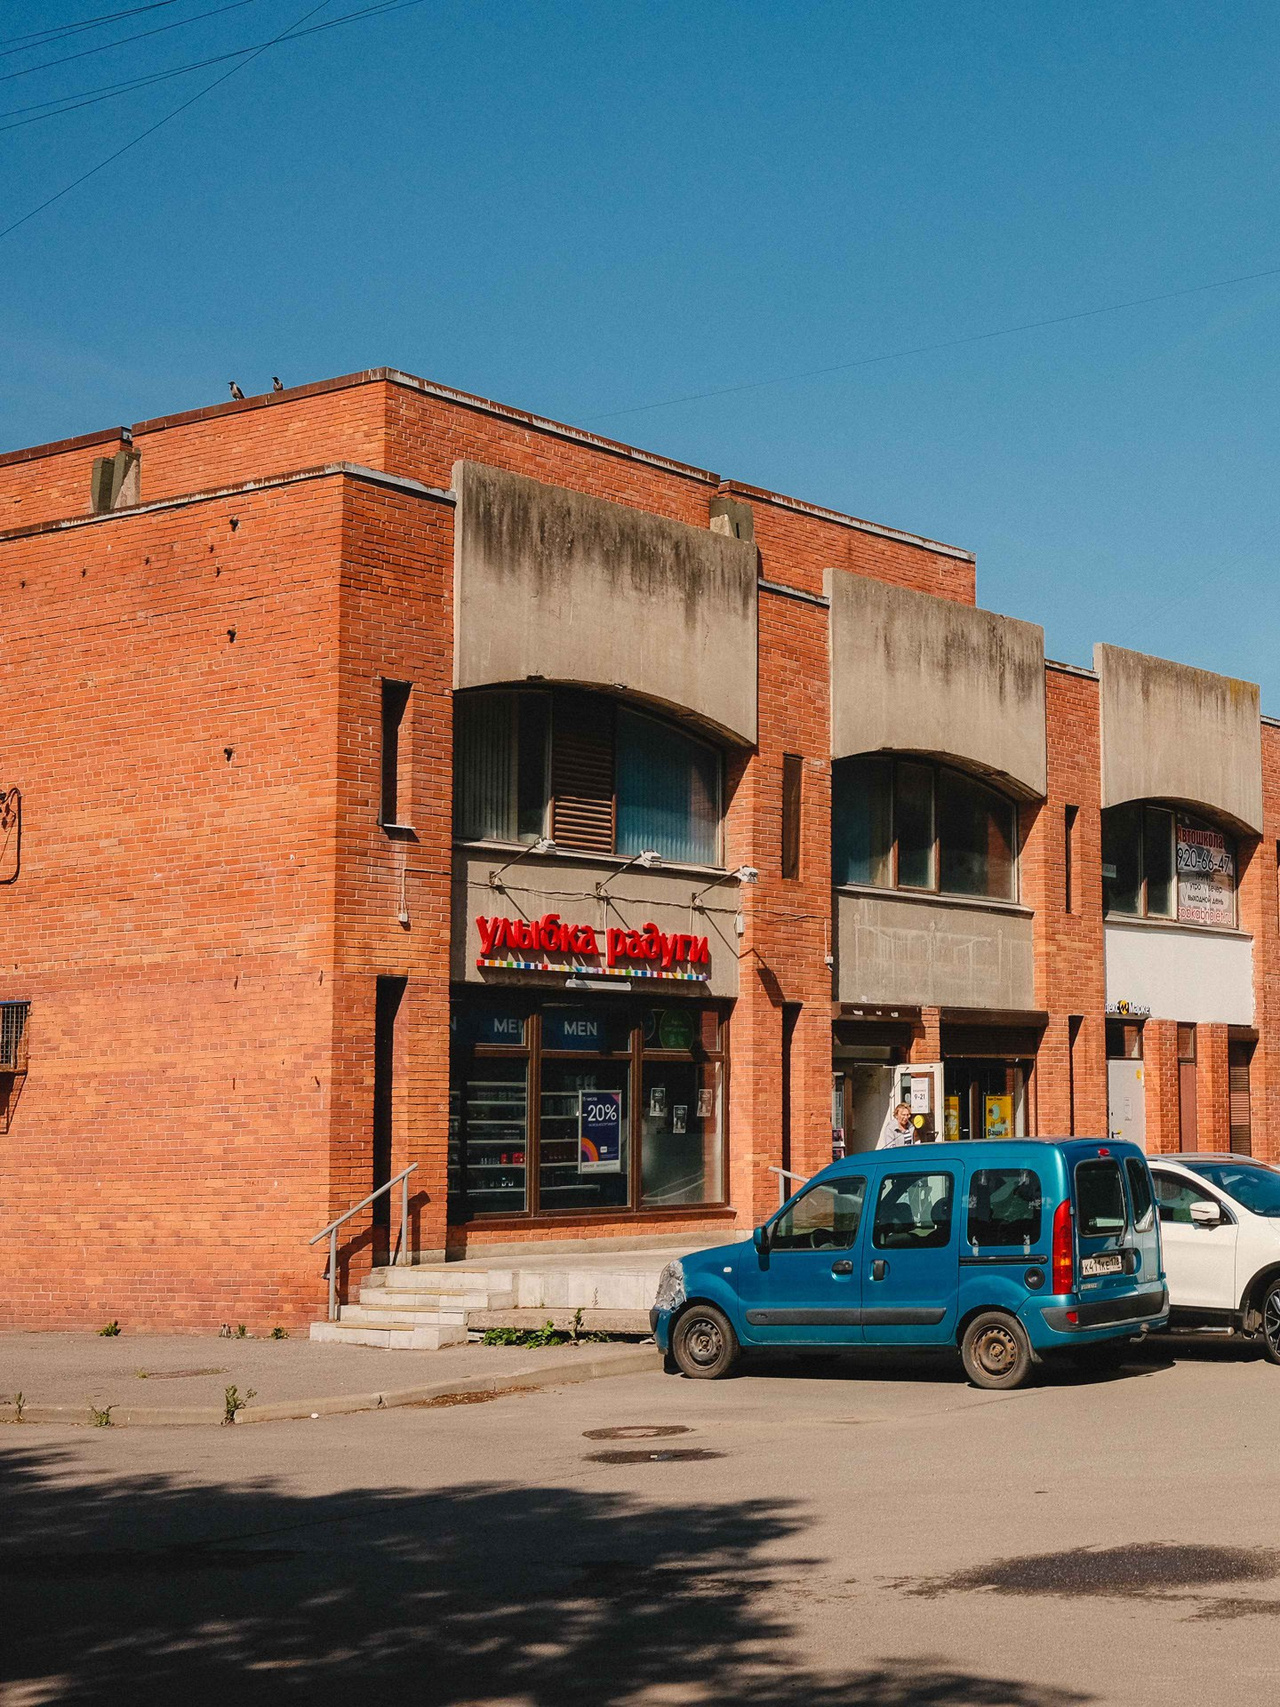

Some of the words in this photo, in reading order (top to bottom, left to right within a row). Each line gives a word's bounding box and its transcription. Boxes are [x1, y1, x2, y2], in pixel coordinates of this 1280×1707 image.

[1177, 847, 1231, 873] 920-66-47
[475, 913, 600, 955] улыбка
[605, 922, 709, 969] радуги
[564, 1021, 598, 1036] MEN
[582, 1104, 618, 1122] -20%
